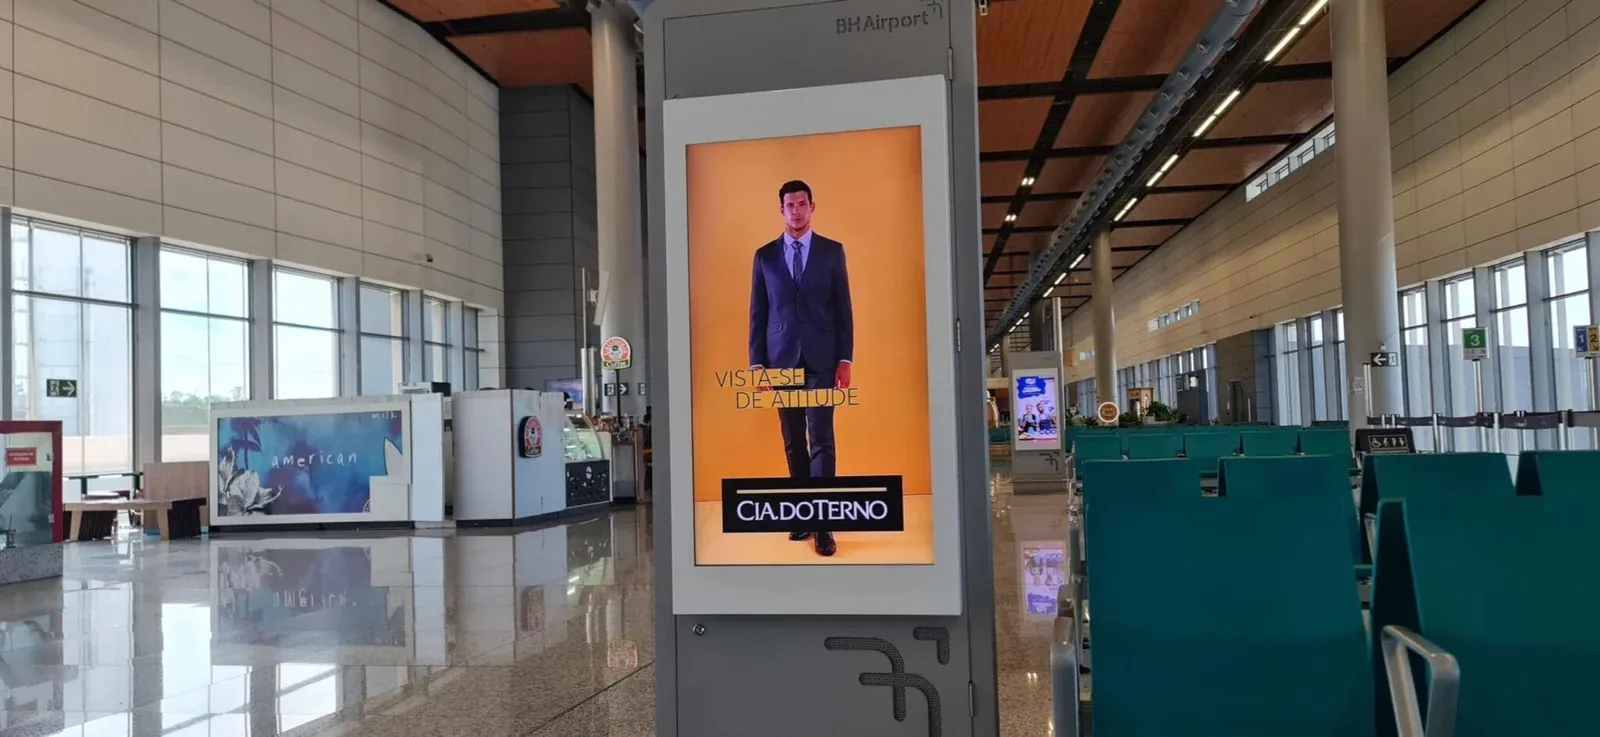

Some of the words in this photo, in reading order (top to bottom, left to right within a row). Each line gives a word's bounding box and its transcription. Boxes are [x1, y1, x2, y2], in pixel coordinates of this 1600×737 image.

[1470, 334, 1480, 347] 3
[1578, 334, 1585, 343] 1
[1590, 334, 1597, 343] 2
[715, 367, 805, 387] VISTA-SE
[736, 390, 764, 409] DE
[772, 387, 860, 409] ATITUDE
[371, 411, 397, 420] milk
[271, 451, 357, 469] american
